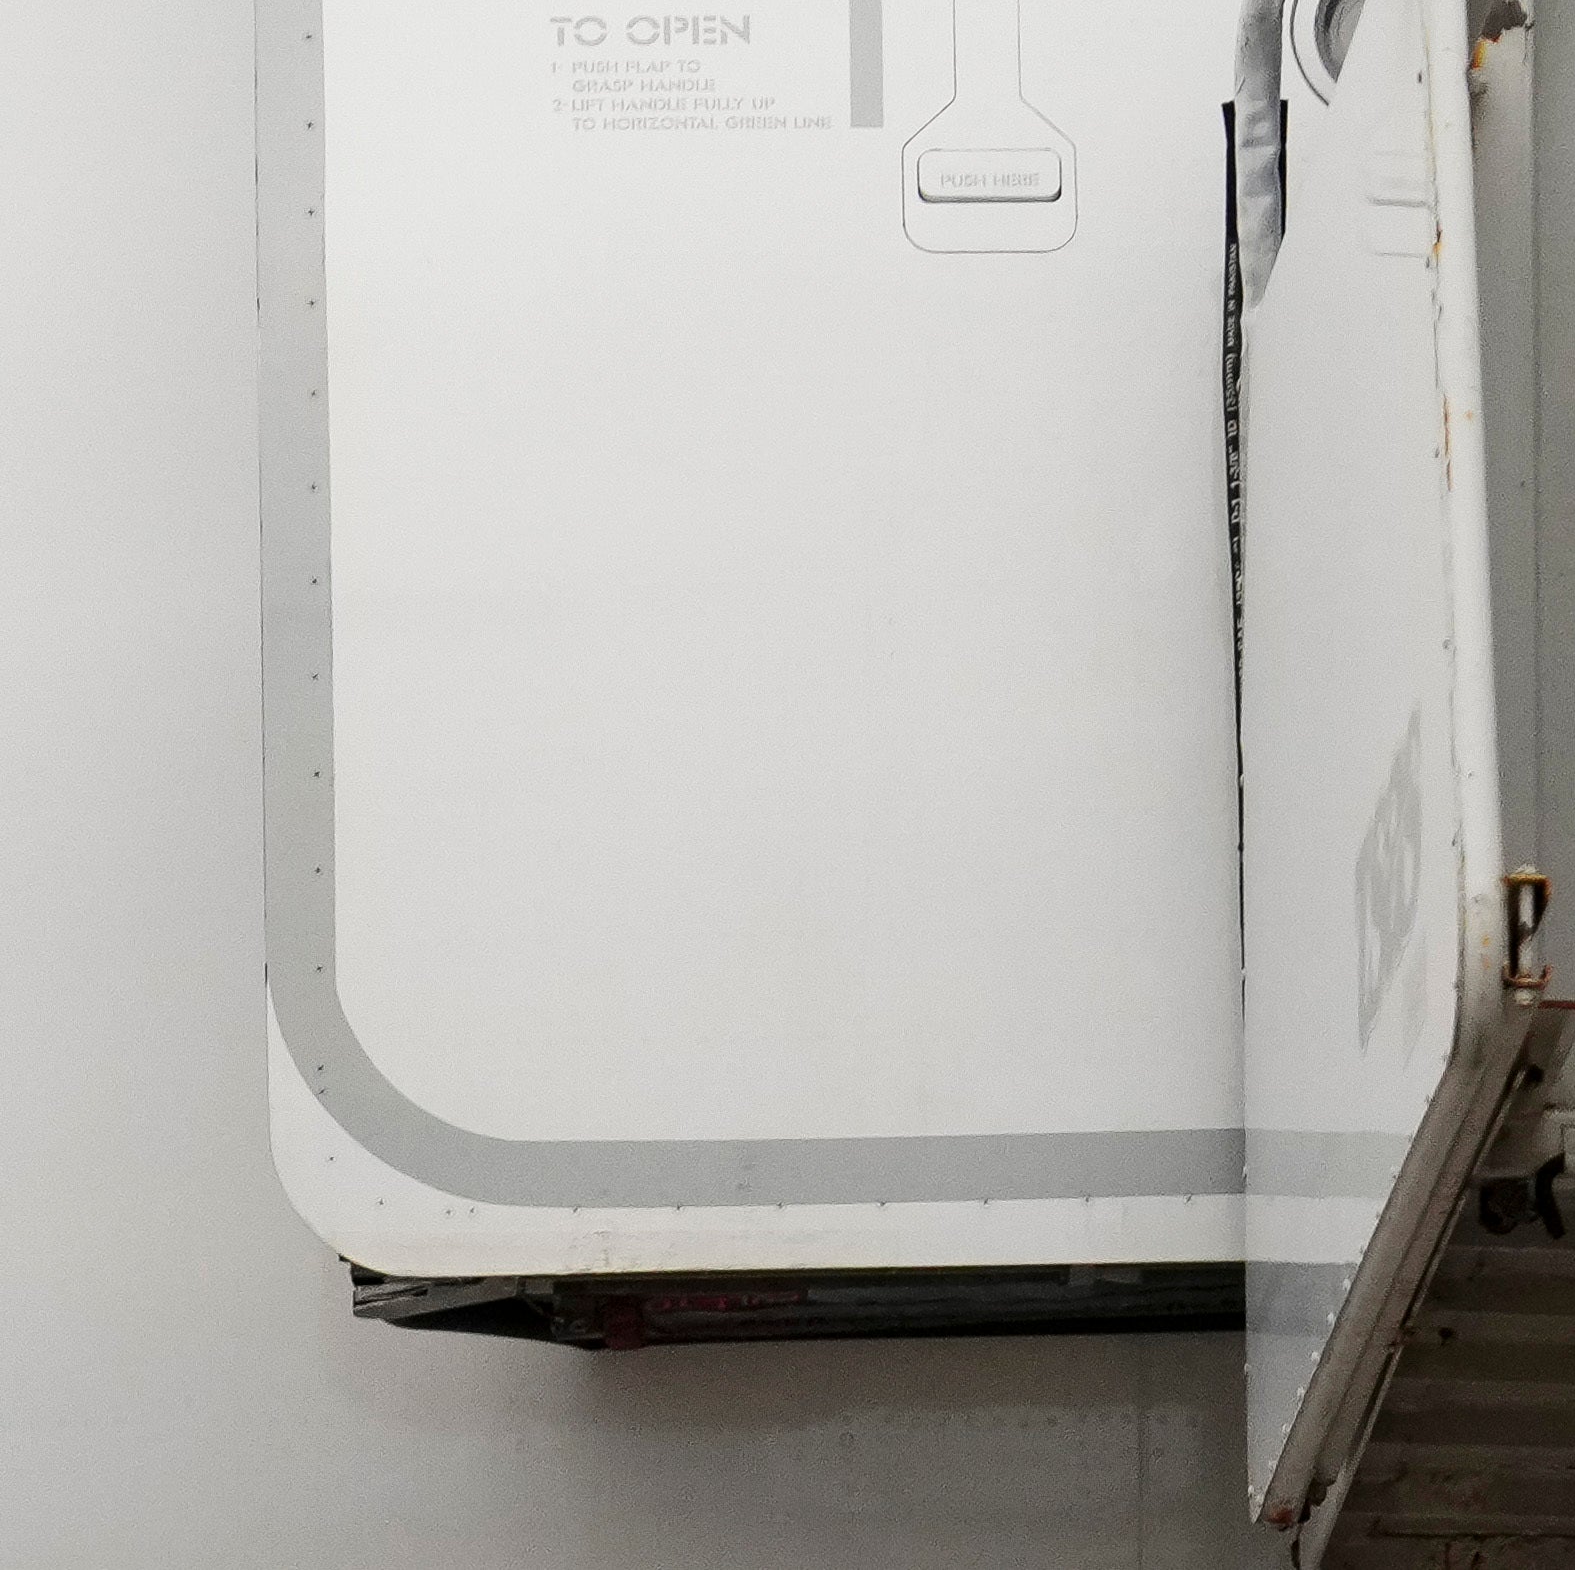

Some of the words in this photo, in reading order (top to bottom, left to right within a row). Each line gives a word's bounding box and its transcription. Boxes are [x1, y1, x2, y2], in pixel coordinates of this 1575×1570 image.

[550, 15, 607, 47] TO
[626, 15, 751, 46] OPEN
[572, 61, 618, 74] PUSH
[678, 59, 701, 73] TO
[572, 79, 633, 93] GRASP
[640, 78, 715, 92] HANDLE
[571, 98, 604, 112] LIFT
[611, 97, 687, 111] HANDLE
[694, 97, 744, 111] FULLY
[752, 97, 776, 111] UP
[573, 117, 596, 131] TO
[603, 116, 718, 131] HORIZONTAL
[725, 116, 787, 130] GREEN
[794, 116, 833, 130] LINE
[941, 173, 987, 187] PUSH
